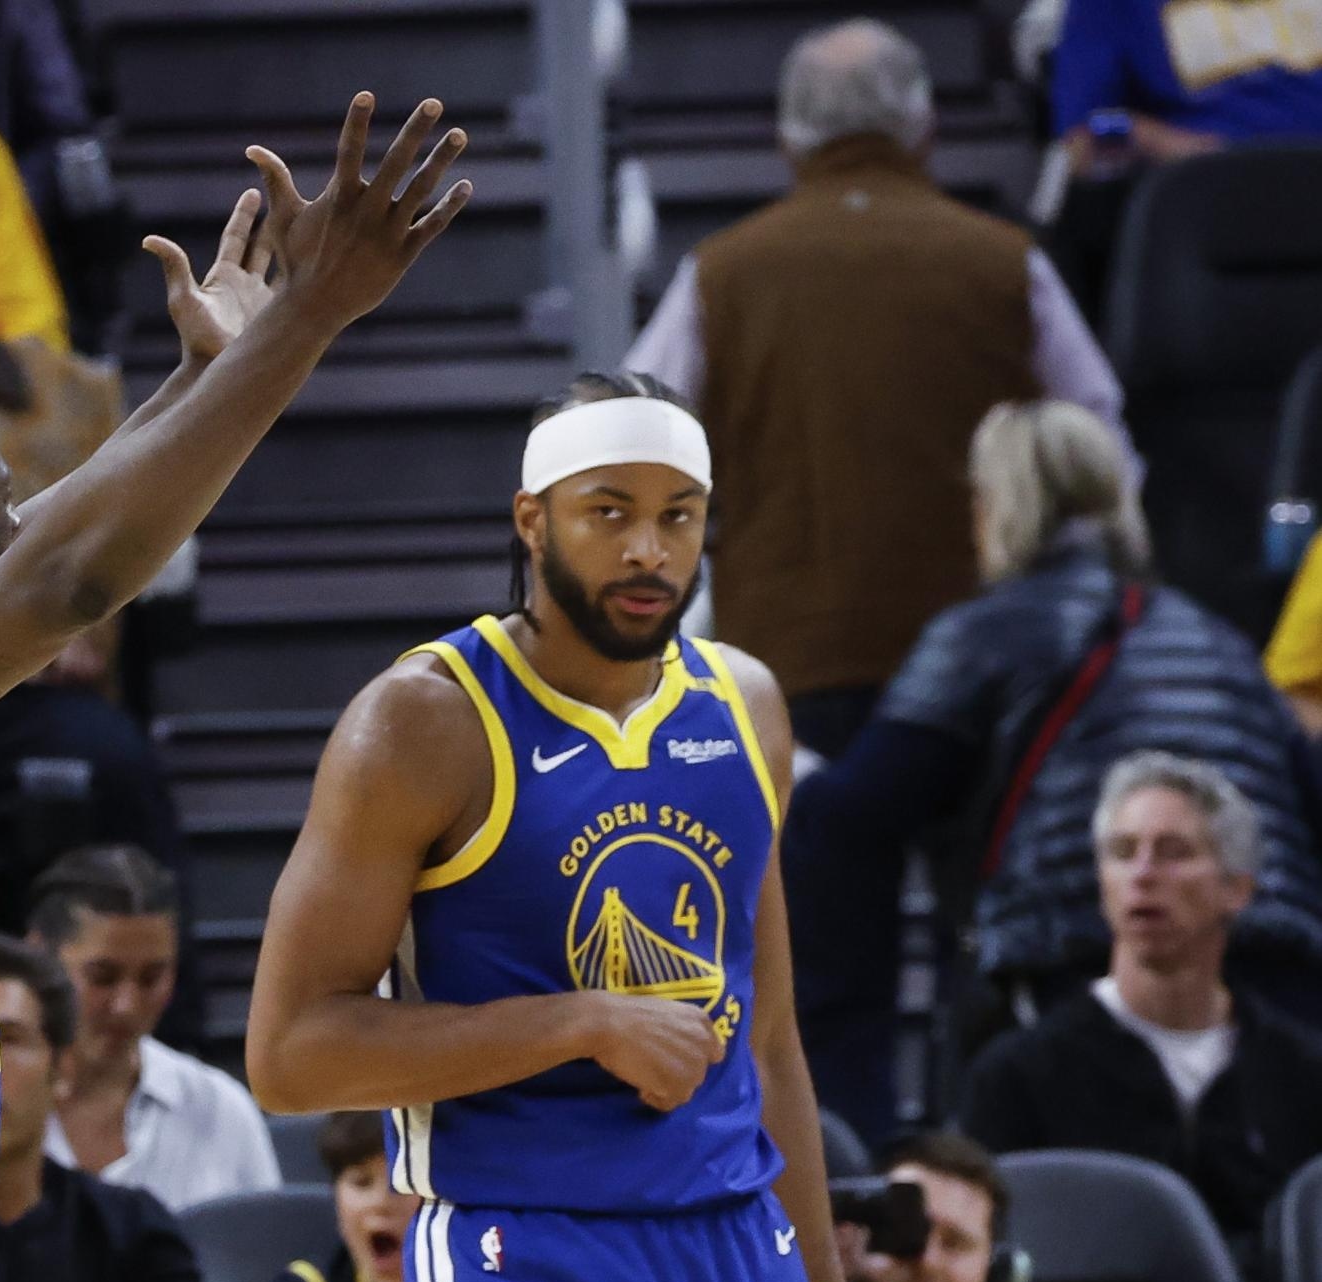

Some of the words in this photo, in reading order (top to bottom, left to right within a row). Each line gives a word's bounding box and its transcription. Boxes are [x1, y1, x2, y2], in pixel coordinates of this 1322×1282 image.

[559, 802, 648, 877] GOLDEN
[658, 804, 733, 869] STATE
[672, 882, 699, 940] 4
